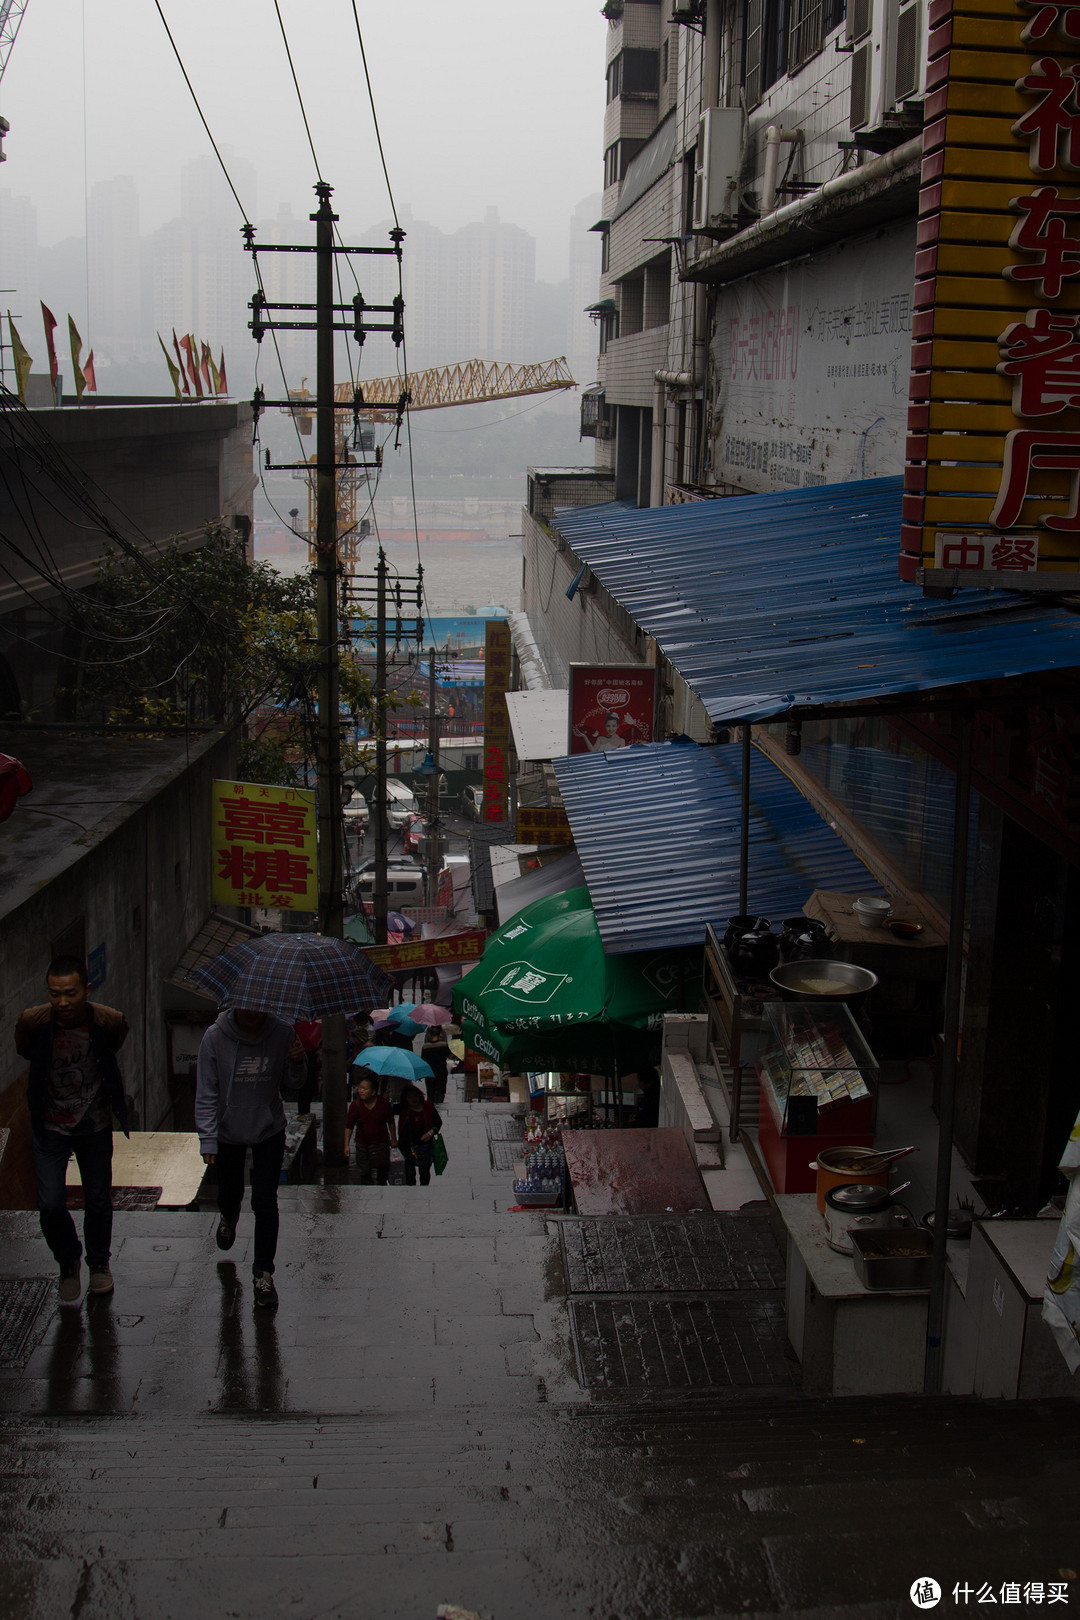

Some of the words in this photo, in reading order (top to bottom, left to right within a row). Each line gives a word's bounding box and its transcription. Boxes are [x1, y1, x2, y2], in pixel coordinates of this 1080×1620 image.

[943, 537, 1036, 570] 中餐
[233, 785, 295, 801] 朝天门
[237, 892, 294, 909] 批发
